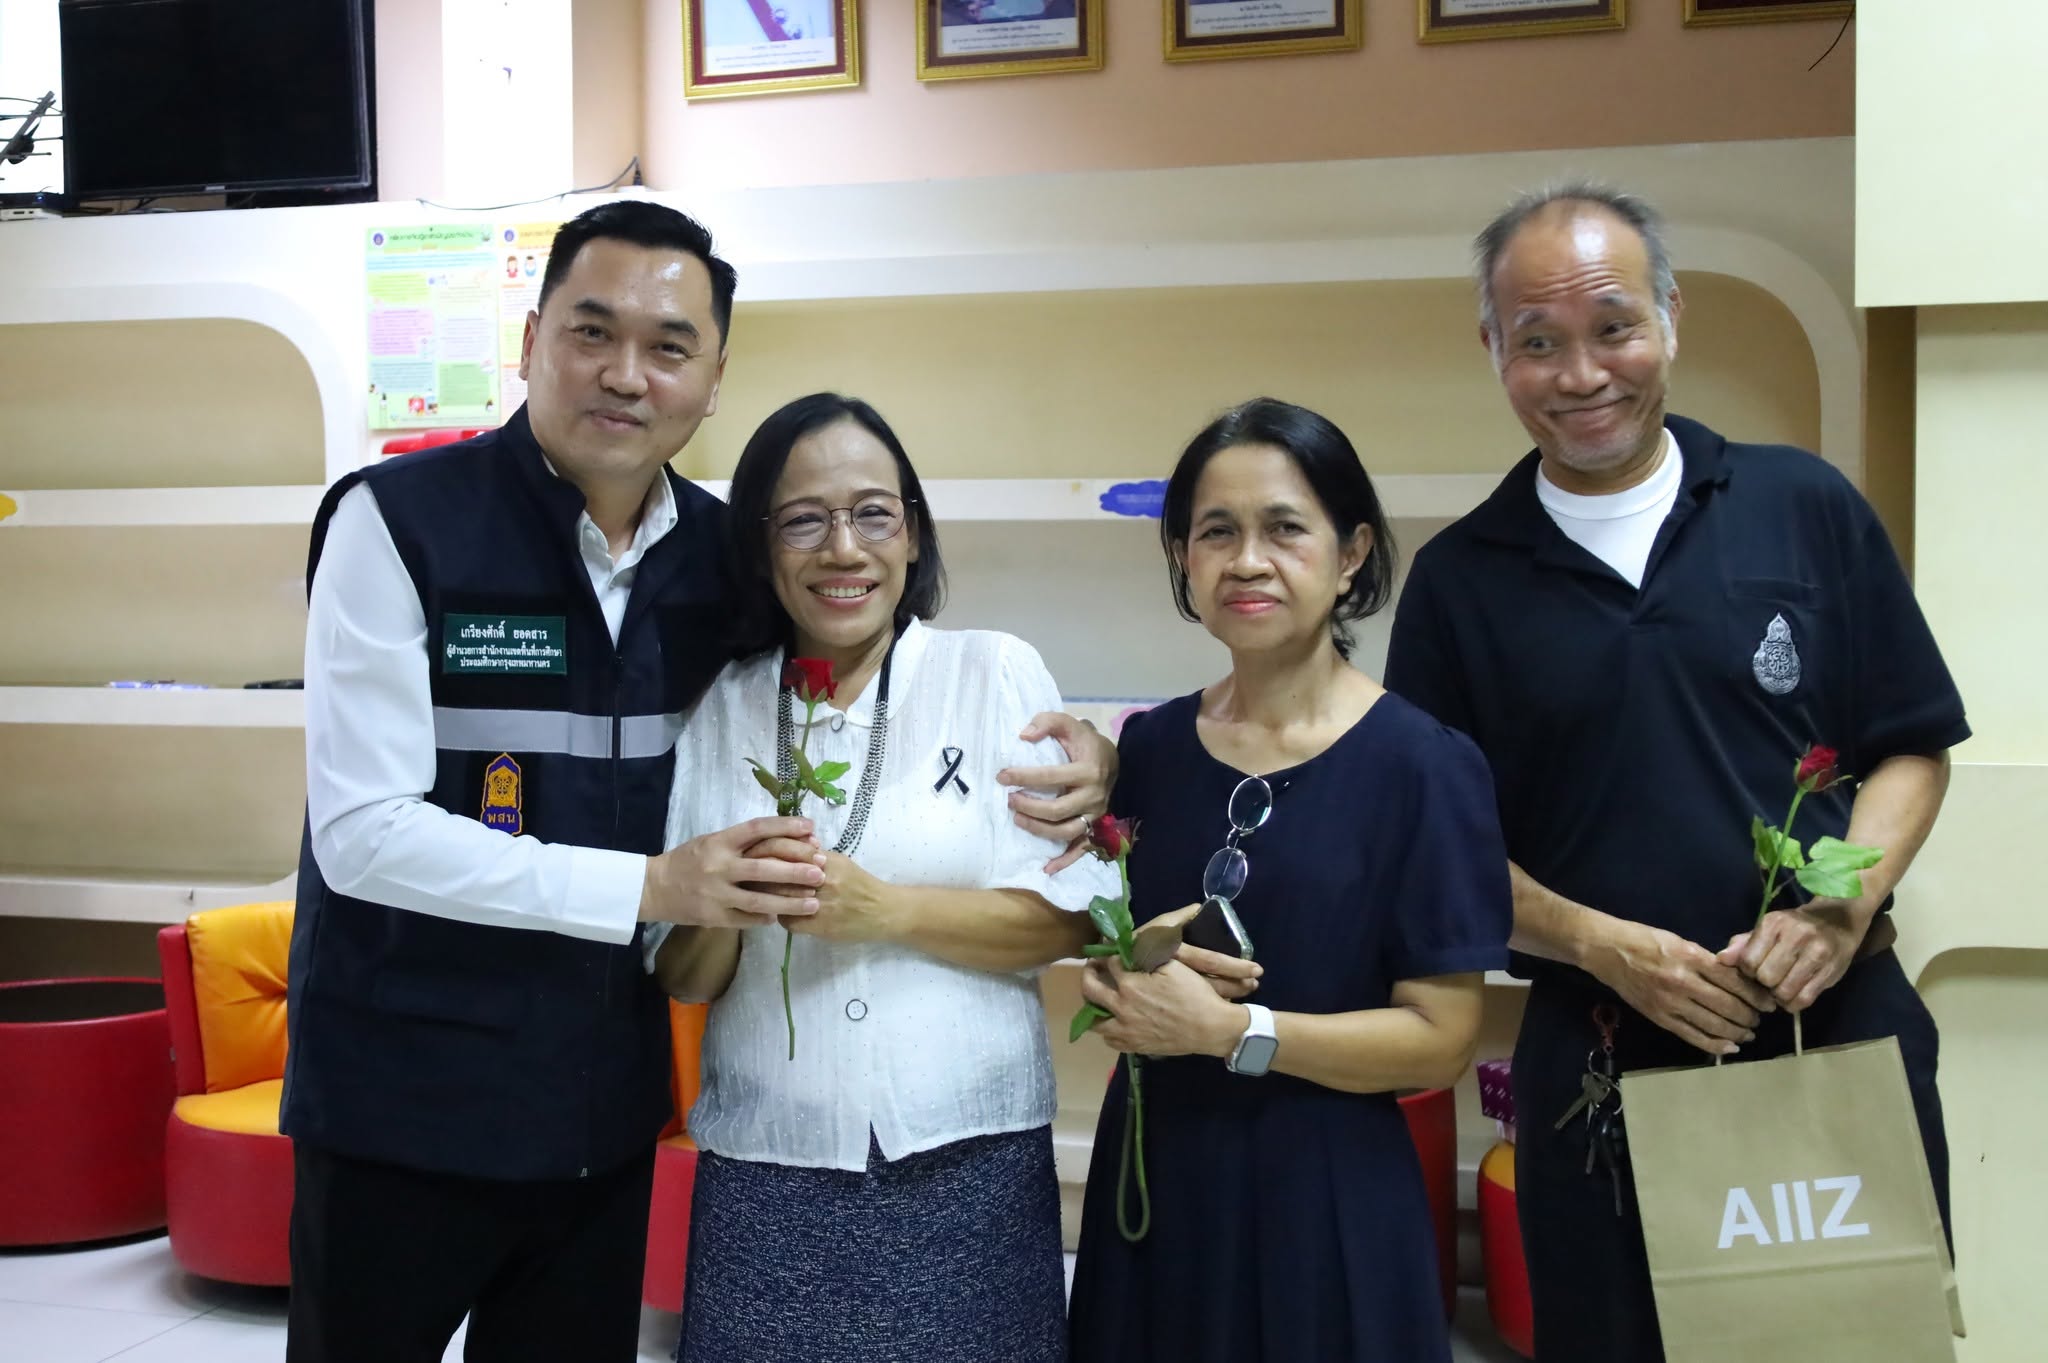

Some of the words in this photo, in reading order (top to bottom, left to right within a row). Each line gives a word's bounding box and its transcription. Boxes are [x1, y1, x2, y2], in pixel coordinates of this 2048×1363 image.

[460, 620, 506, 639] เกรียงศักดิ์
[513, 628, 548, 640] ยอดสาร
[446, 642, 563, 658] ผู้อำนวยการสำนักงานเขตพื้นที่การศึกษา
[460, 656, 551, 670] ประถมศึกษากรุงเทพมหานคร
[1717, 1175, 1870, 1249] AIIZ
